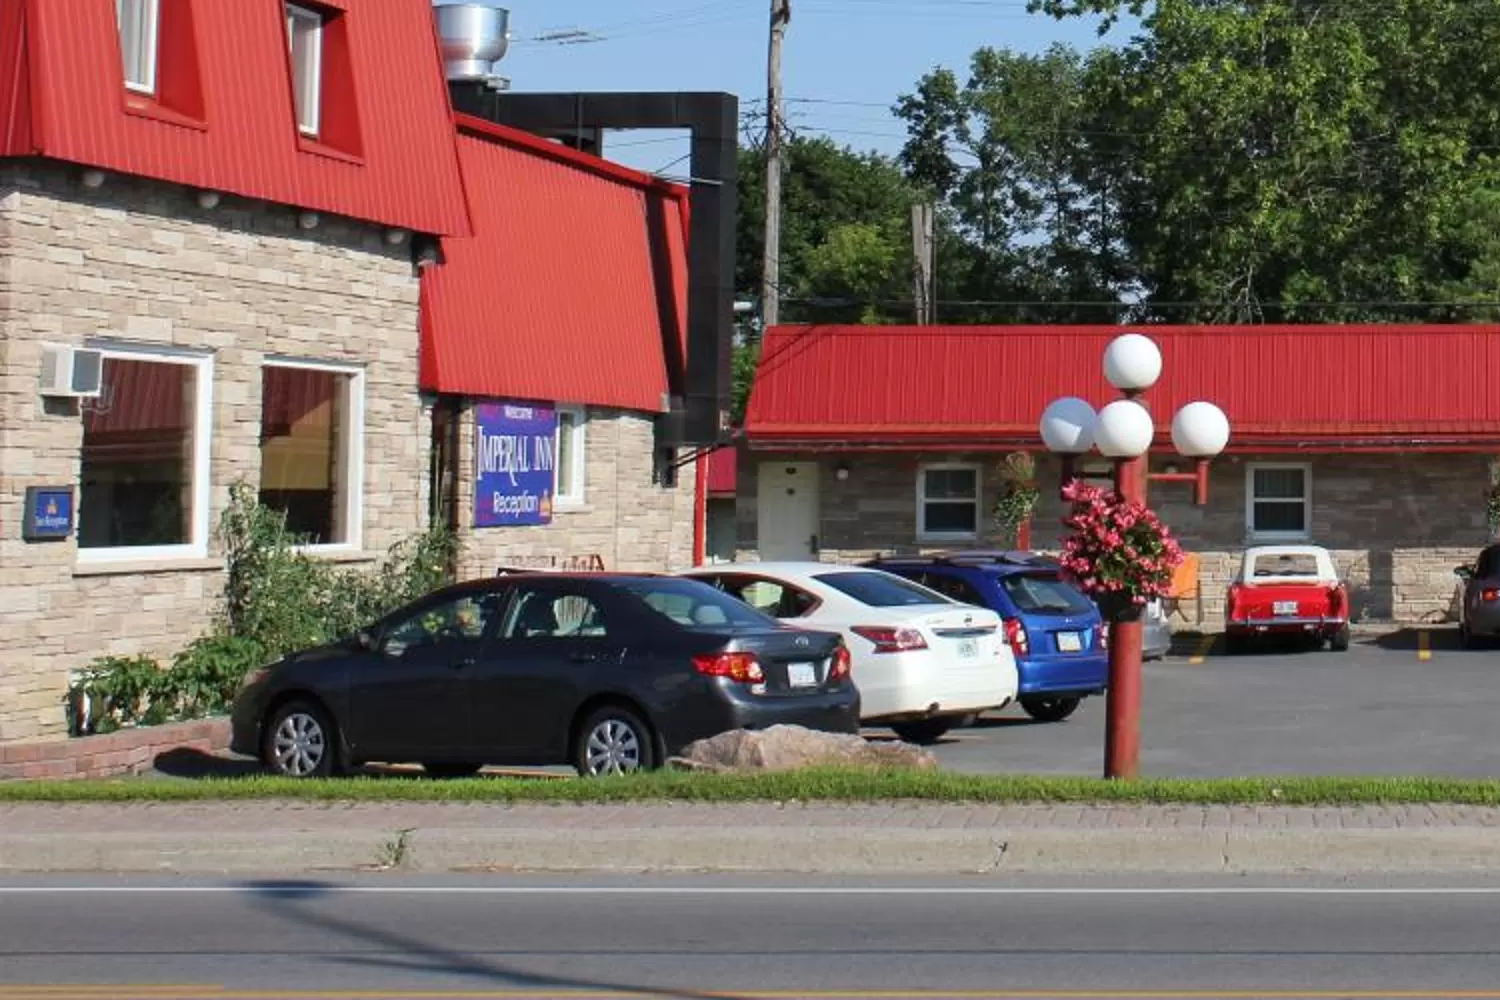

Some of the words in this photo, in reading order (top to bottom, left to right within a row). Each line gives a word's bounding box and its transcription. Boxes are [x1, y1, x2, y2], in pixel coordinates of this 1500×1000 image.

[477, 425, 529, 487] IMPERIAL
[533, 435, 553, 471] INN
[493, 490, 539, 518] Reception
